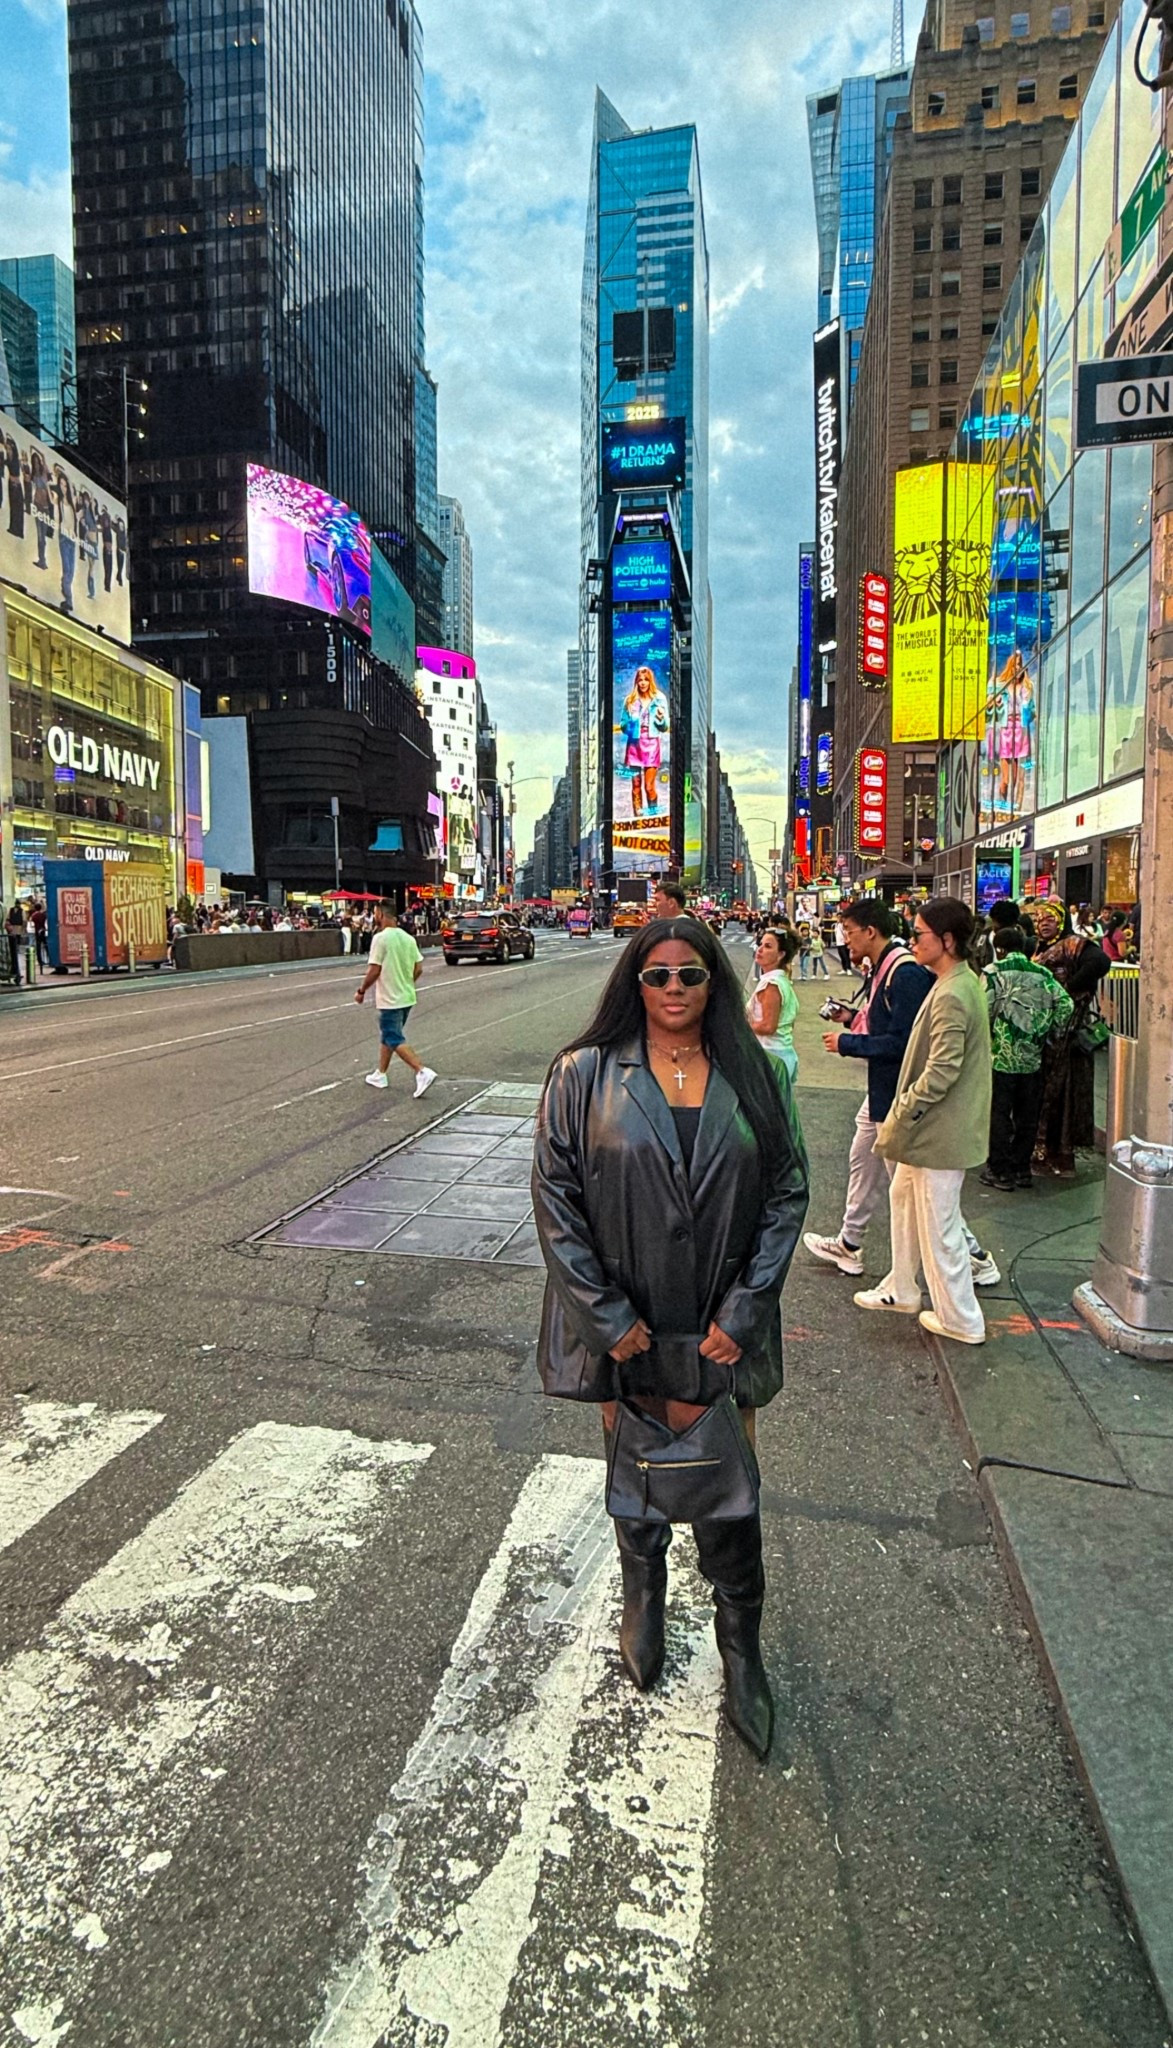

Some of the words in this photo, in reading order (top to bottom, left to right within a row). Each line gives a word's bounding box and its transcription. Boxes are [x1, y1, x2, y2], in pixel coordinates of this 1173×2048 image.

[1134, 193, 1145, 242] 7
[1118, 311, 1148, 358] ONE
[627, 405, 660, 421] 2025
[611, 447, 626, 459] #1
[629, 443, 676, 457] DRAMA
[621, 455, 666, 469] RETURNS
[817, 377, 838, 602] twitch.tv/kaicenat
[628, 555, 654, 567] HIGH
[615, 564, 668, 577] POTENTIAL
[649, 578, 666, 586] hulu
[897, 632, 909, 641] THE
[904, 638, 938, 650] MUSICAL
[47, 725, 99, 773] OLD
[103, 743, 161, 791] NAVY
[641, 815, 671, 829] SCENE
[85, 846, 104, 861] OLD
[105, 849, 131, 863] NAVY
[978, 869, 1010, 878] EAGLES
[110, 875, 163, 906] RECHARGE
[65, 903, 86, 915] NOT
[65, 914, 87, 925] ALONE
[112, 898, 164, 947] STATION
